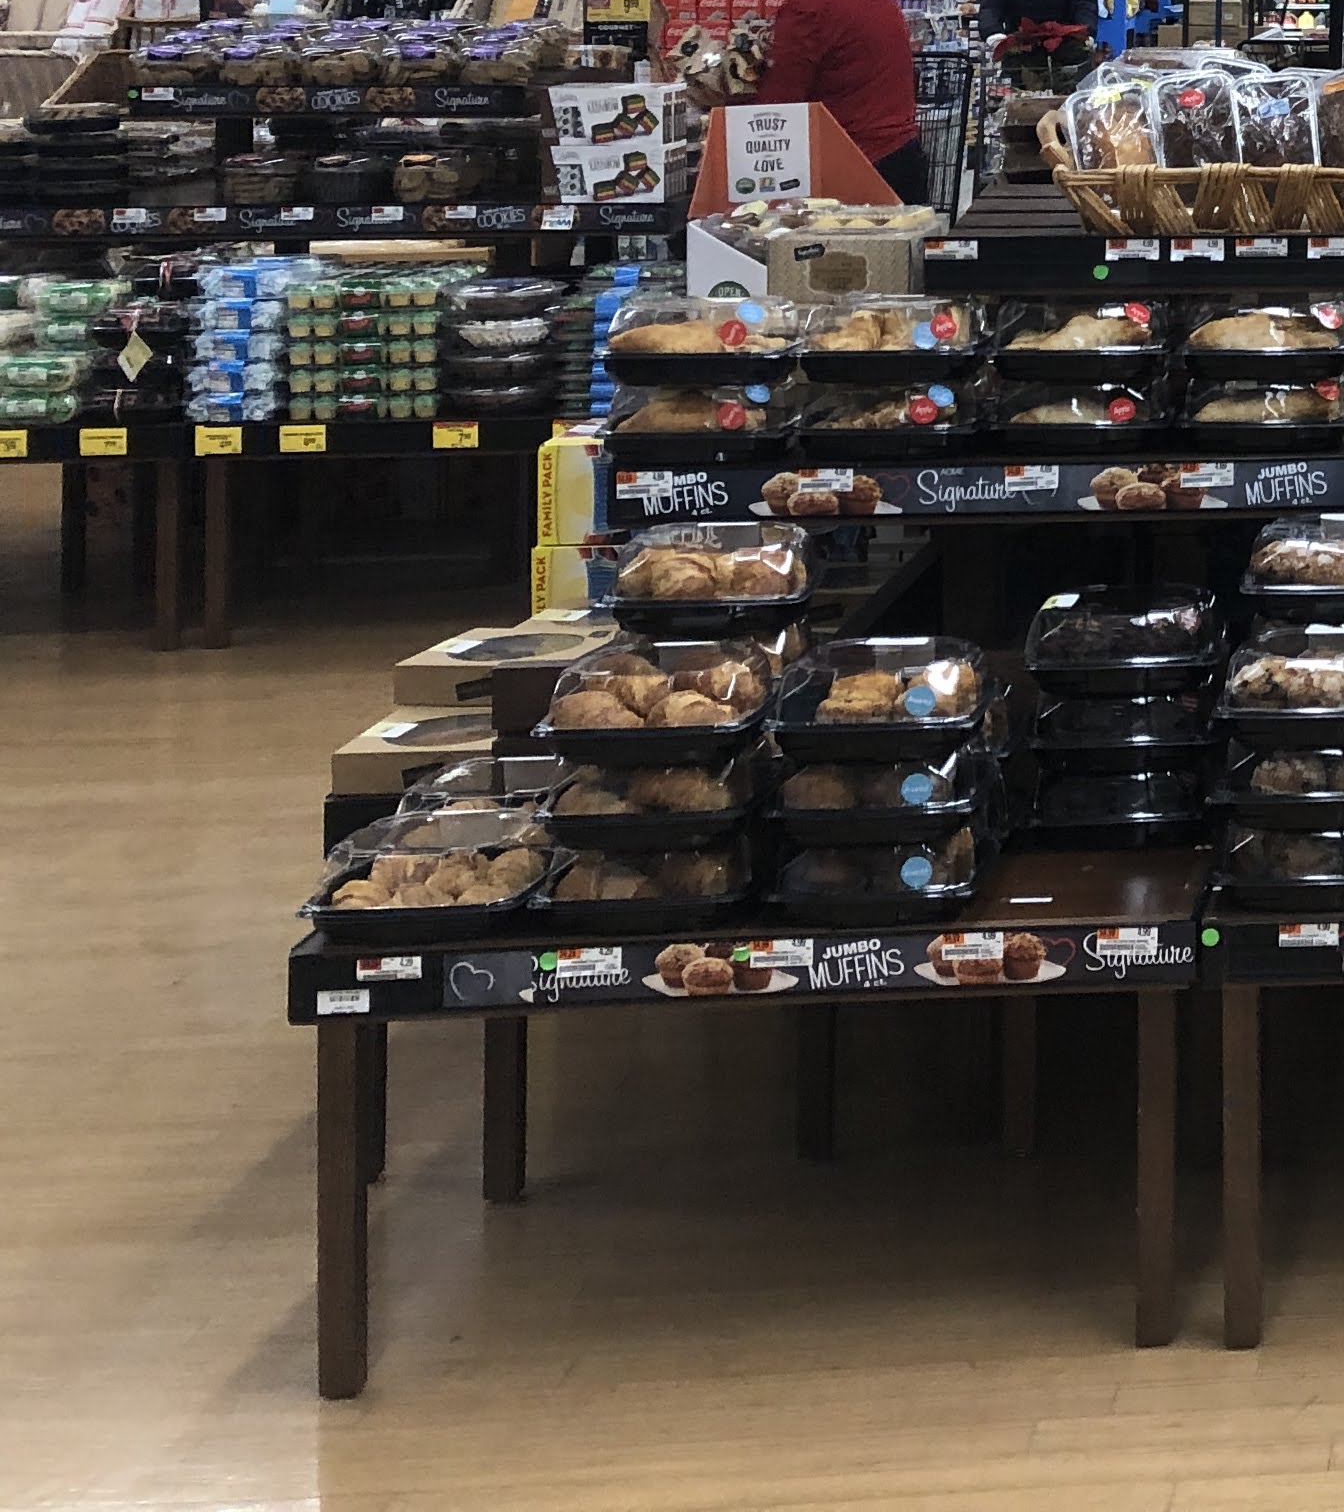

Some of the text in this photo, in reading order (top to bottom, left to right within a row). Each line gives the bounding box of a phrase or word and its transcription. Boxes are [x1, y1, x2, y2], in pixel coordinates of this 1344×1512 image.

[311, 92, 361, 108] COOKIES
[748, 118, 787, 133] TRUST
[745, 139, 791, 154] QUALITY
[754, 158, 785, 174] LOVE
[477, 207, 526, 228] COOKIES
[672, 472, 708, 487] MBO
[1257, 461, 1308, 481] JUMBO
[542, 453, 553, 539] FAMILY PACK
[642, 480, 729, 517] MUFFINS
[917, 469, 1017, 512] Signature
[1245, 471, 1328, 506] MUFFINS
[536, 556, 546, 591] PACK
[822, 939, 881, 961] JUMBO
[1082, 932, 1194, 979] Signature
[531, 956, 631, 1003] ignature
[810, 949, 905, 990] MUFFINS
